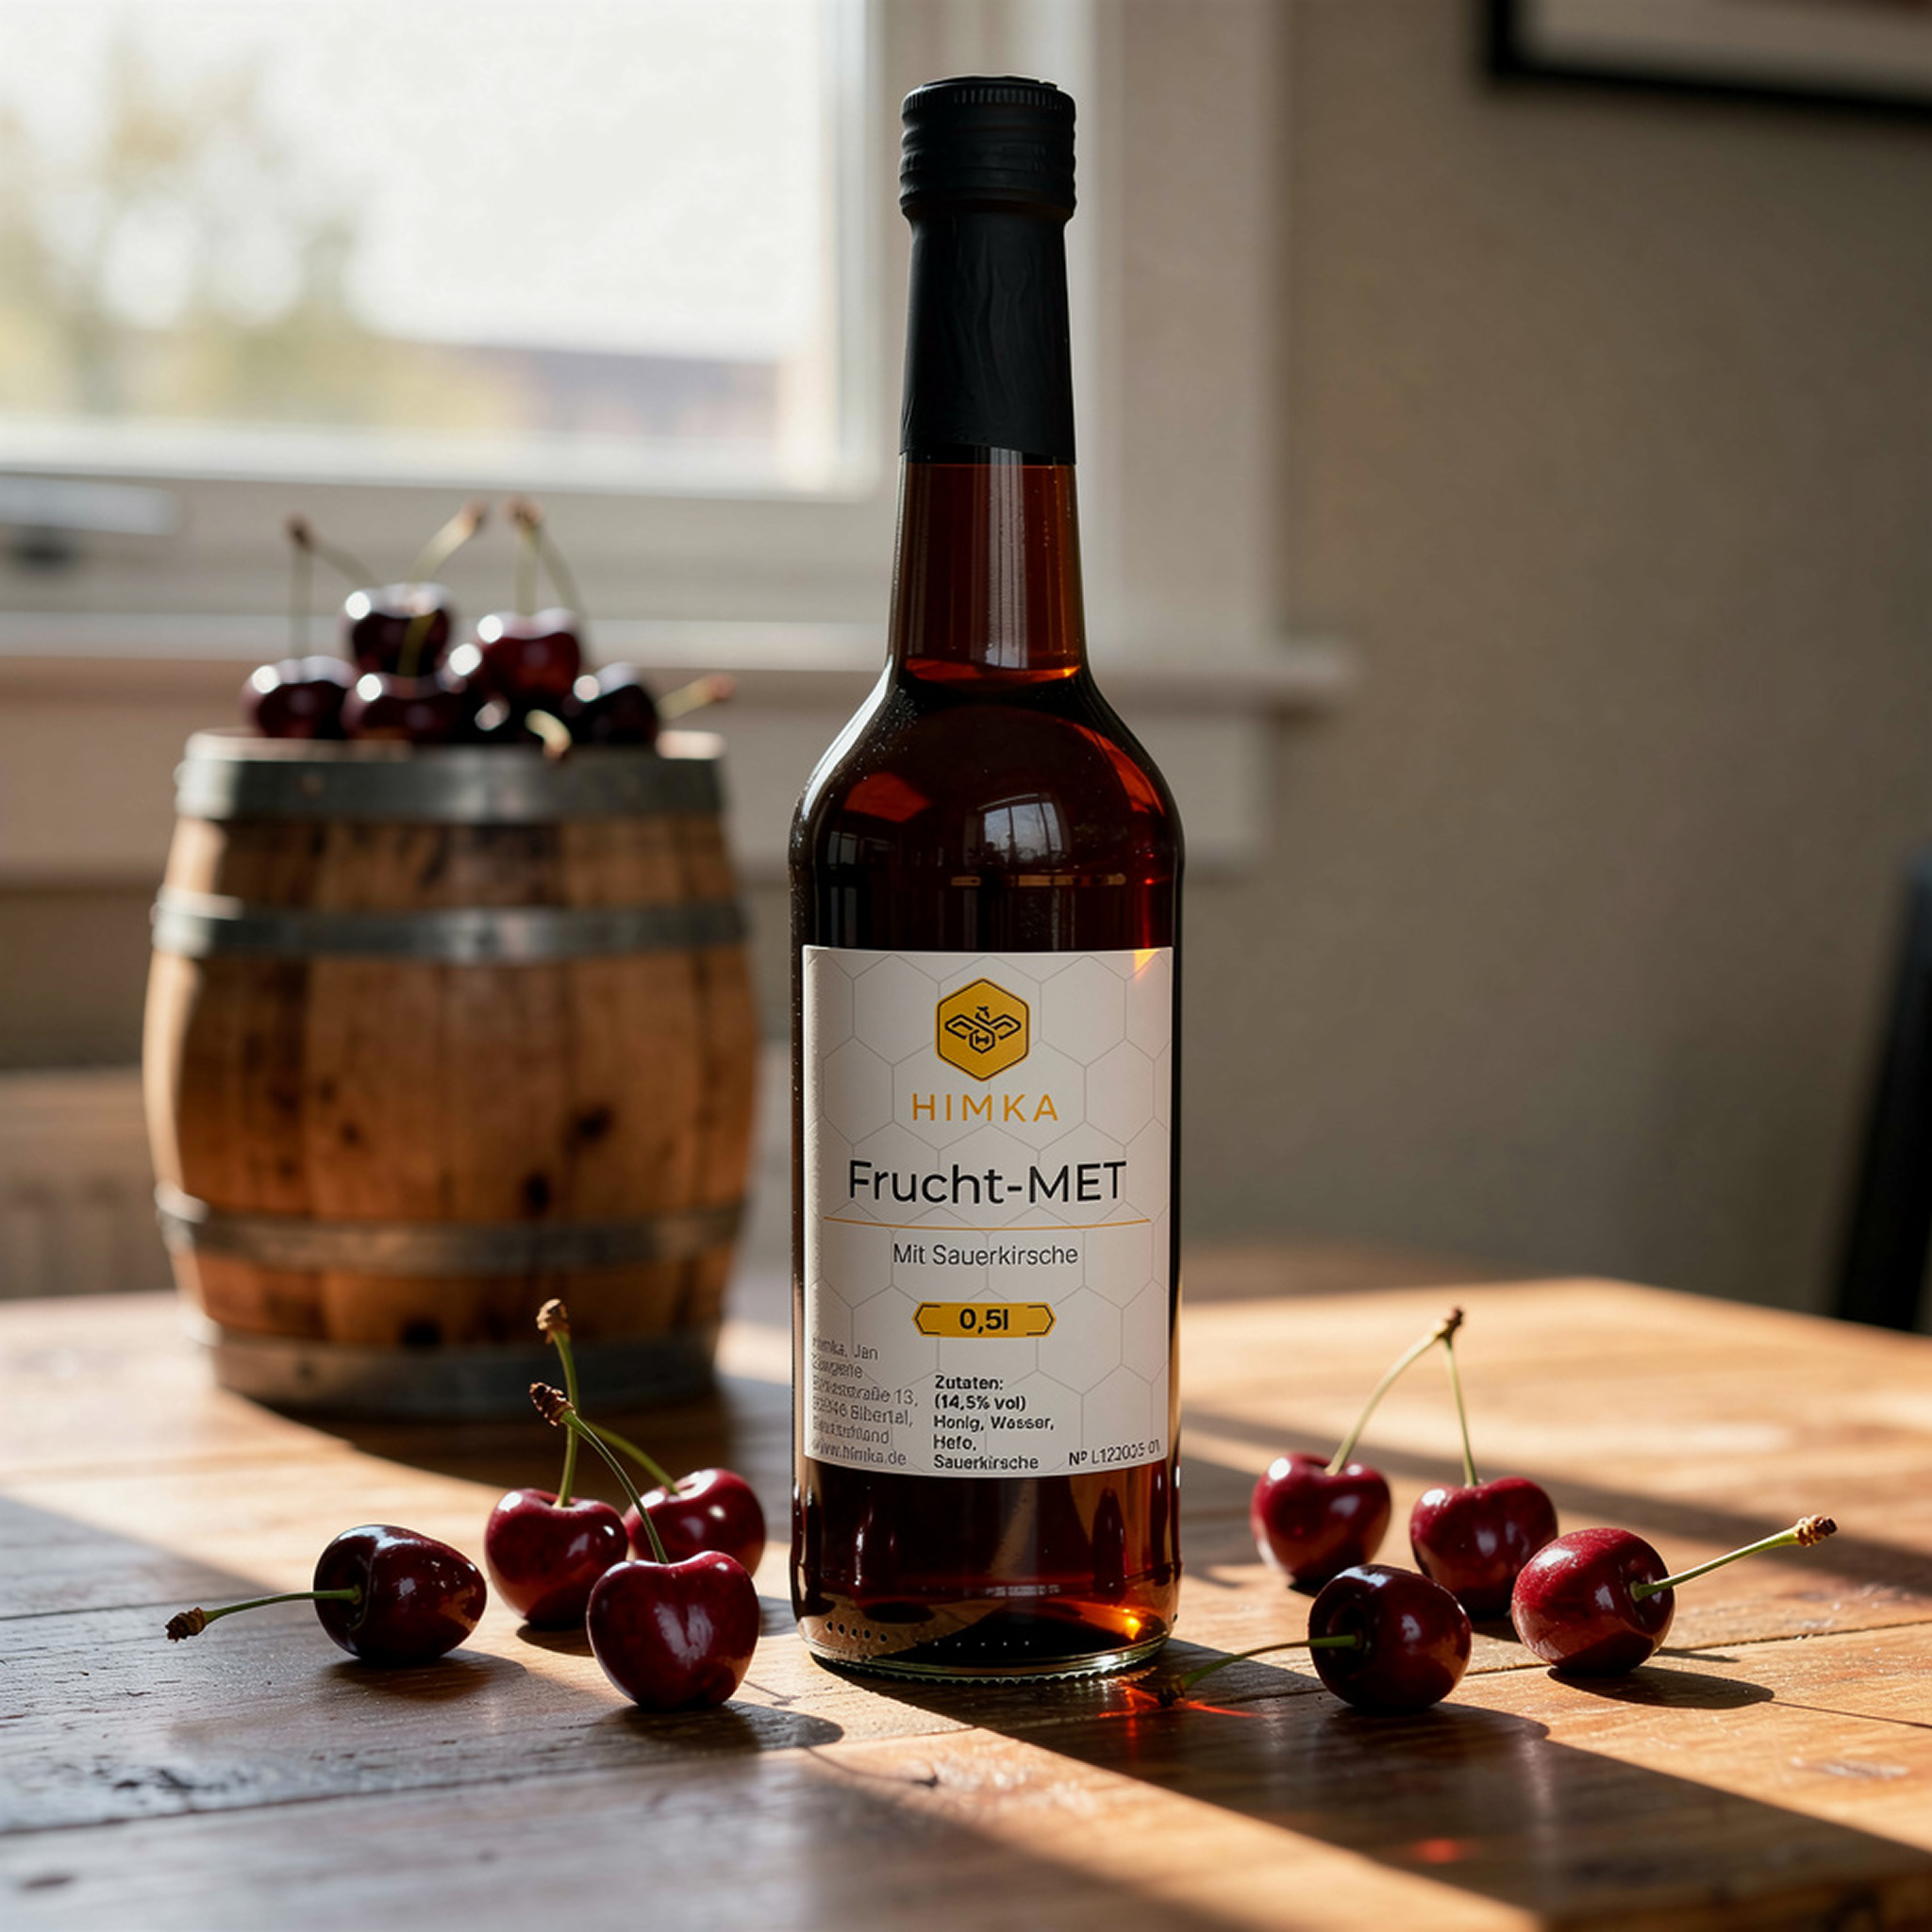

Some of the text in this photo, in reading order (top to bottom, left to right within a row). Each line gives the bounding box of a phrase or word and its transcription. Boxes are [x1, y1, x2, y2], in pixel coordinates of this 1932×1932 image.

[912, 1093, 1058, 1122] HIMKA
[849, 1159, 1127, 1204] Frucht-MET
[893, 1243, 1078, 1266] Mit Sauerkirsche
[959, 1308, 1008, 1334] 0,5l
[854, 1344, 878, 1360] Jan
[934, 1374, 1004, 1391] Zutaten:
[934, 1394, 1026, 1411] (14,5% vol)
[933, 1454, 1039, 1470] Sauerkirsche
